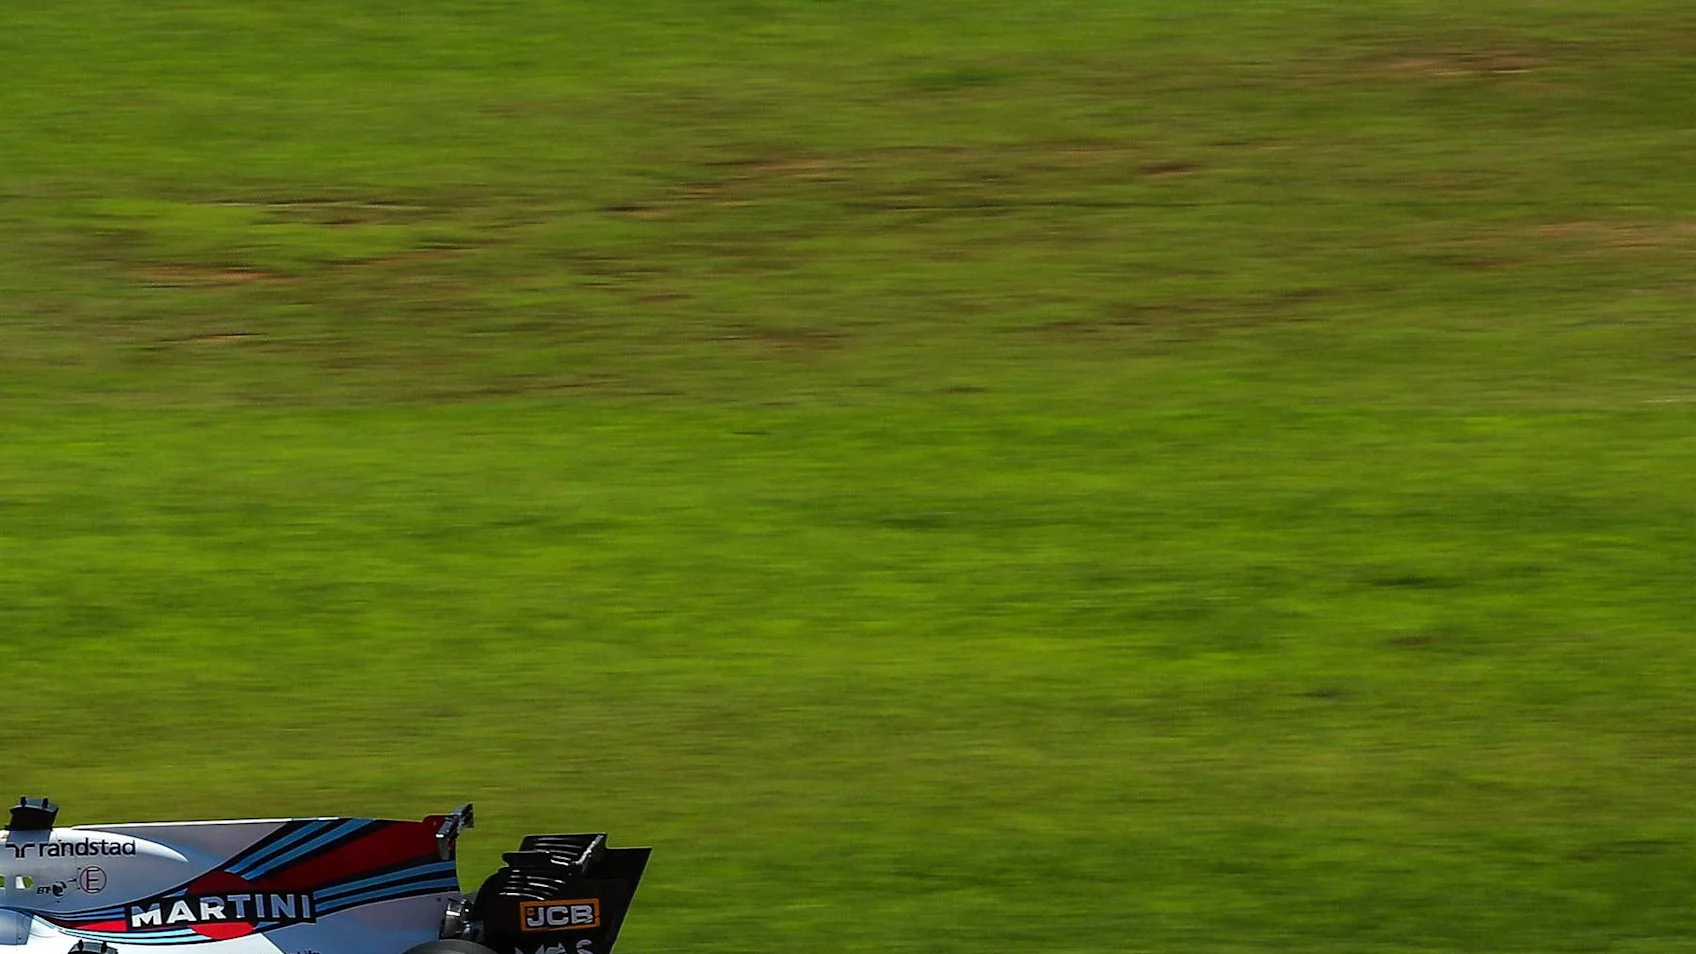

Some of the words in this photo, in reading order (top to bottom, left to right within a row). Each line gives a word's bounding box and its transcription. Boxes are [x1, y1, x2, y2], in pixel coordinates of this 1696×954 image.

[39, 837, 136, 857] randstad
[86, 869, 101, 892] E
[131, 893, 311, 928] MARTINI
[526, 904, 593, 927] JCB
